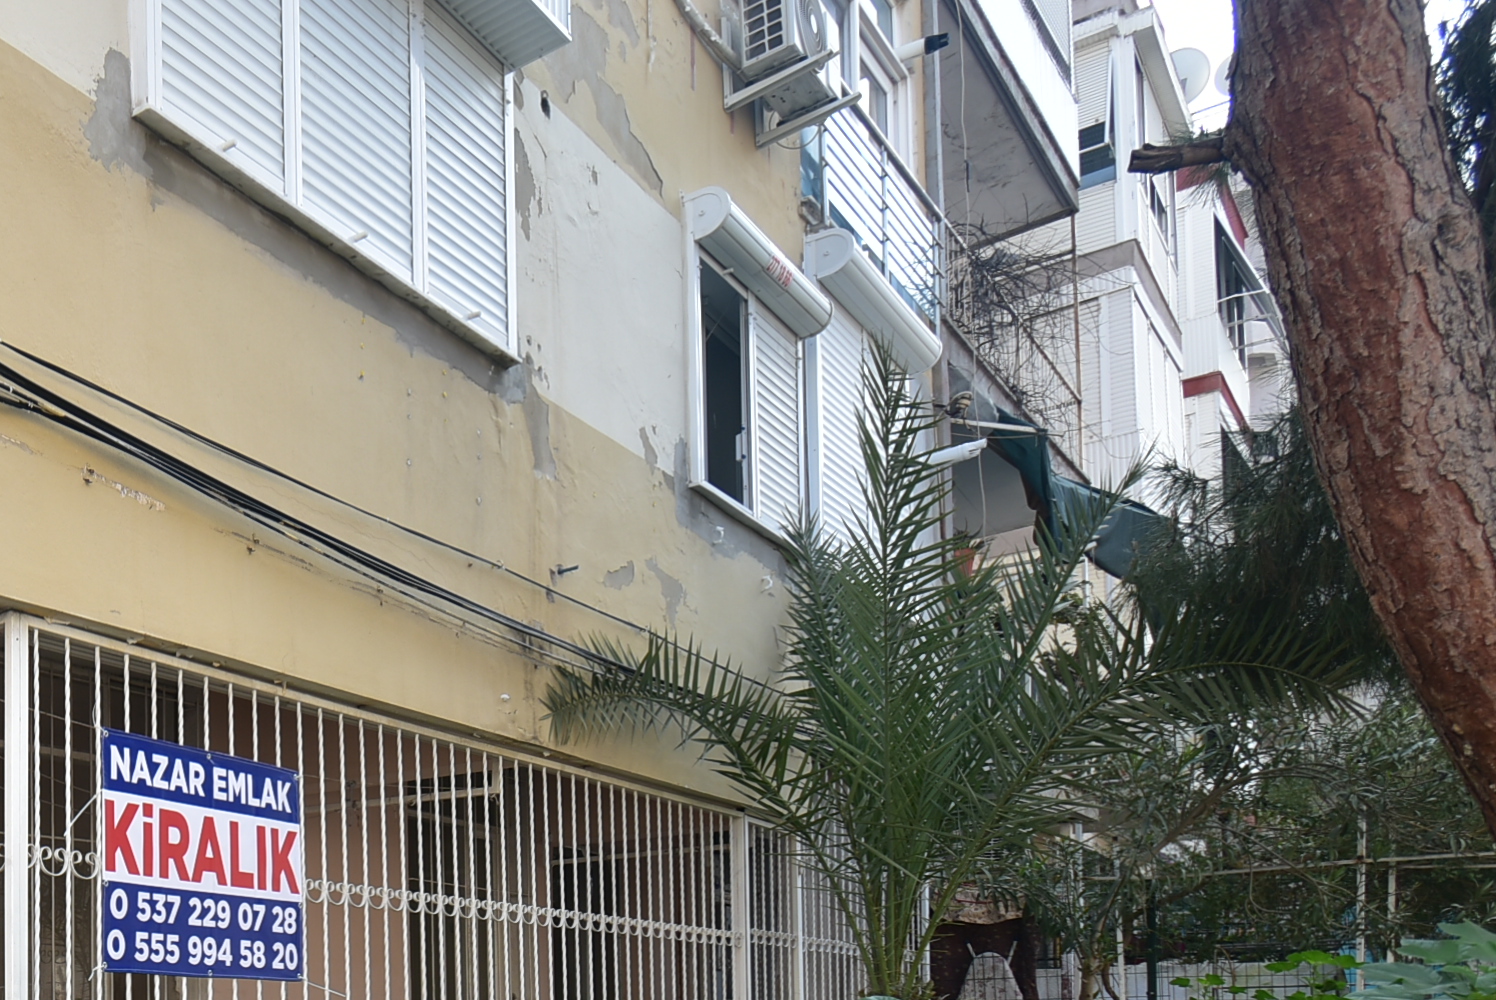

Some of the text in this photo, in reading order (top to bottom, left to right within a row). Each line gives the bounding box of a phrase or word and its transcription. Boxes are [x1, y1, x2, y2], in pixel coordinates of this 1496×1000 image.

[109, 744, 292, 814] NAZAR EMLAK
[136, 891, 181, 924] 537
[188, 897, 231, 929] 229
[237, 902, 266, 932] 07
[271, 905, 297, 935] 28
[134, 931, 180, 964] 555
[187, 936, 233, 967] 994
[239, 939, 266, 969] 58
[272, 942, 298, 971] 20
